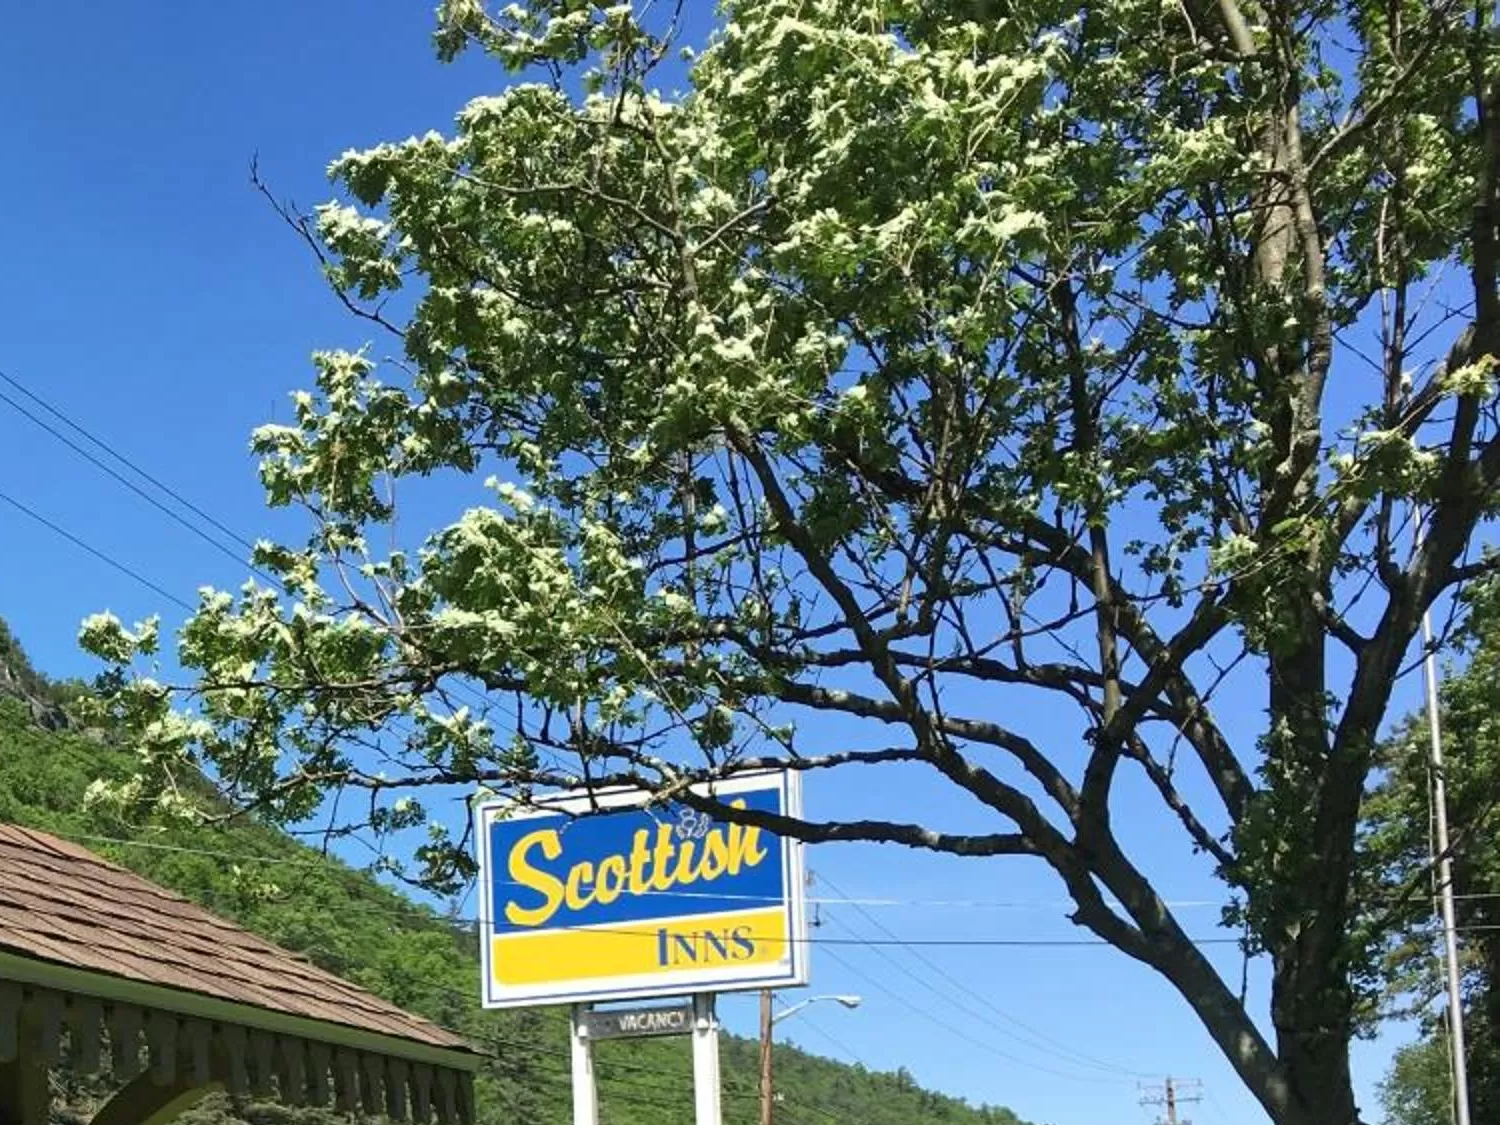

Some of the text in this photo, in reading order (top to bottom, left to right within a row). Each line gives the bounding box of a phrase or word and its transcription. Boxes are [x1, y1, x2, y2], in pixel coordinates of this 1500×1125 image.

[505, 798, 767, 926] Scottish
[658, 926, 755, 966] INNS
[618, 1010, 686, 1031] VACANCY
